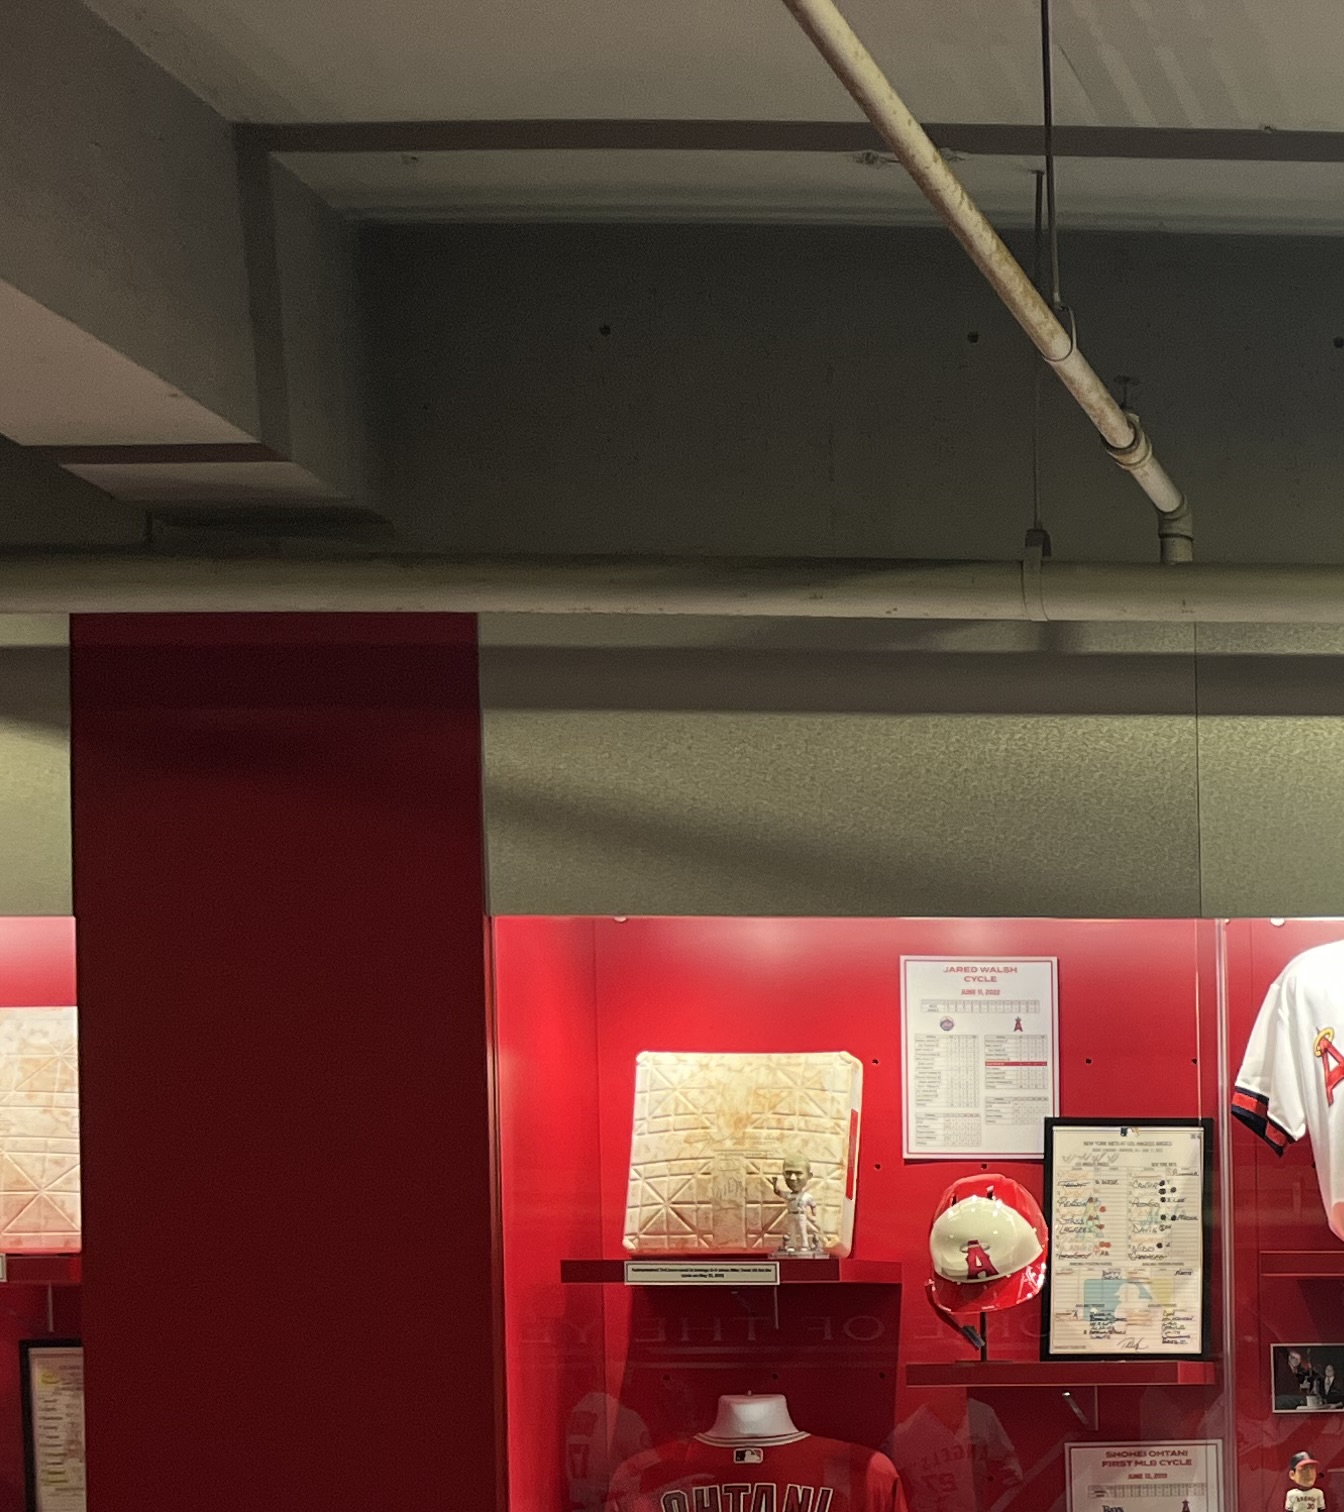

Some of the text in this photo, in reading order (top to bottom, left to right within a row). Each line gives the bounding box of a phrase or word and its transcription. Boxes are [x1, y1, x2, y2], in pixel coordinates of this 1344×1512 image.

[944, 966, 1018, 974] JARED WALSH
[964, 975, 998, 983] CYCLE
[965, 1240, 1000, 1280] A
[1105, 1450, 1189, 1458] SHOHEI OHTANI
[1102, 1459, 1193, 1467] FIRST MLB CYCLE
